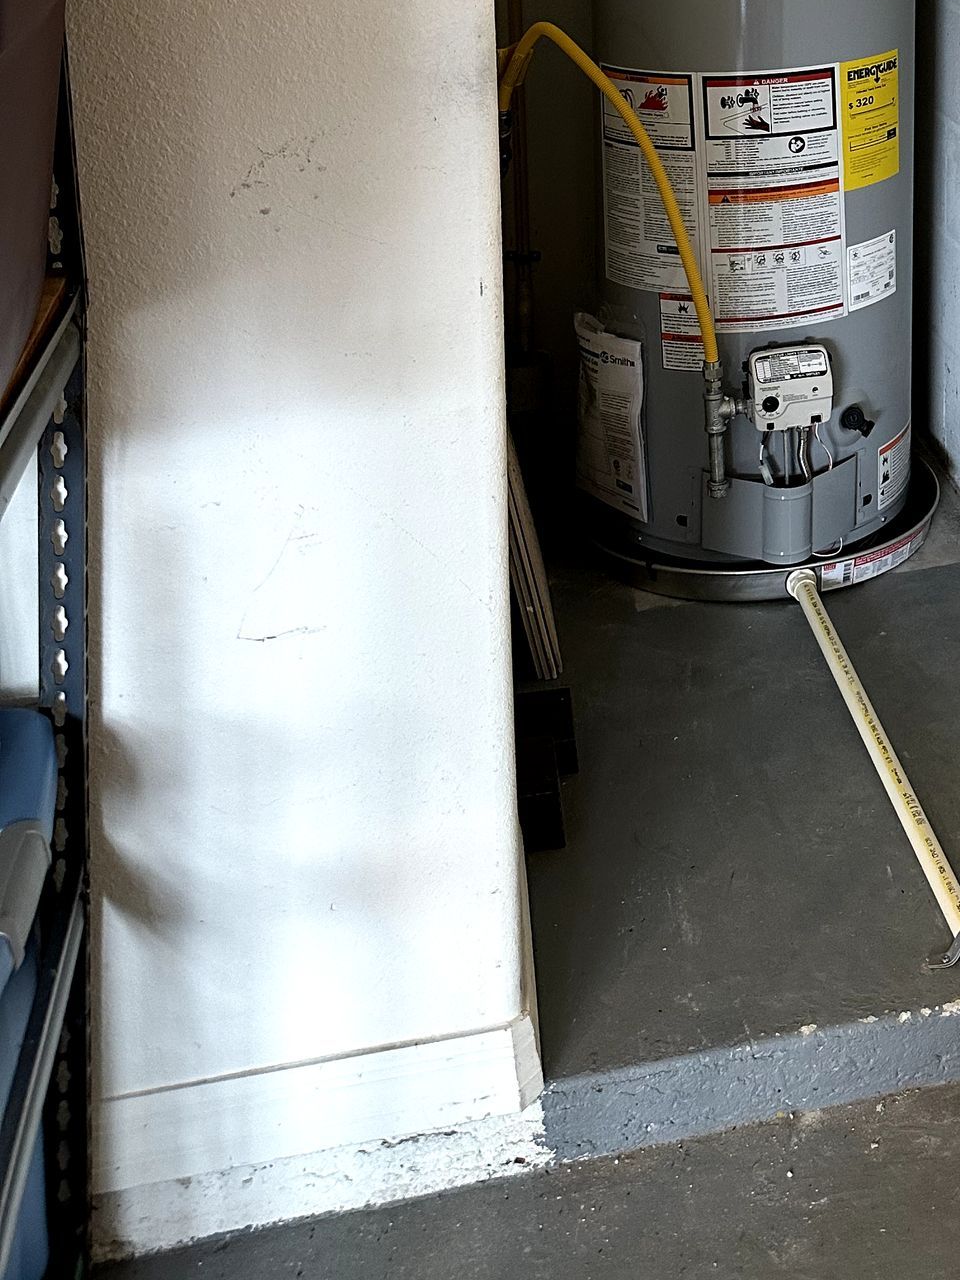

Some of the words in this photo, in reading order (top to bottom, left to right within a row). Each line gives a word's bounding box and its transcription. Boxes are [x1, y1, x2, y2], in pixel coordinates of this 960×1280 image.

[847, 58, 897, 82] ENERGYGUIDE
[761, 77, 788, 86] DANGER
[848, 102, 854, 110] $
[856, 95, 874, 108] 320
